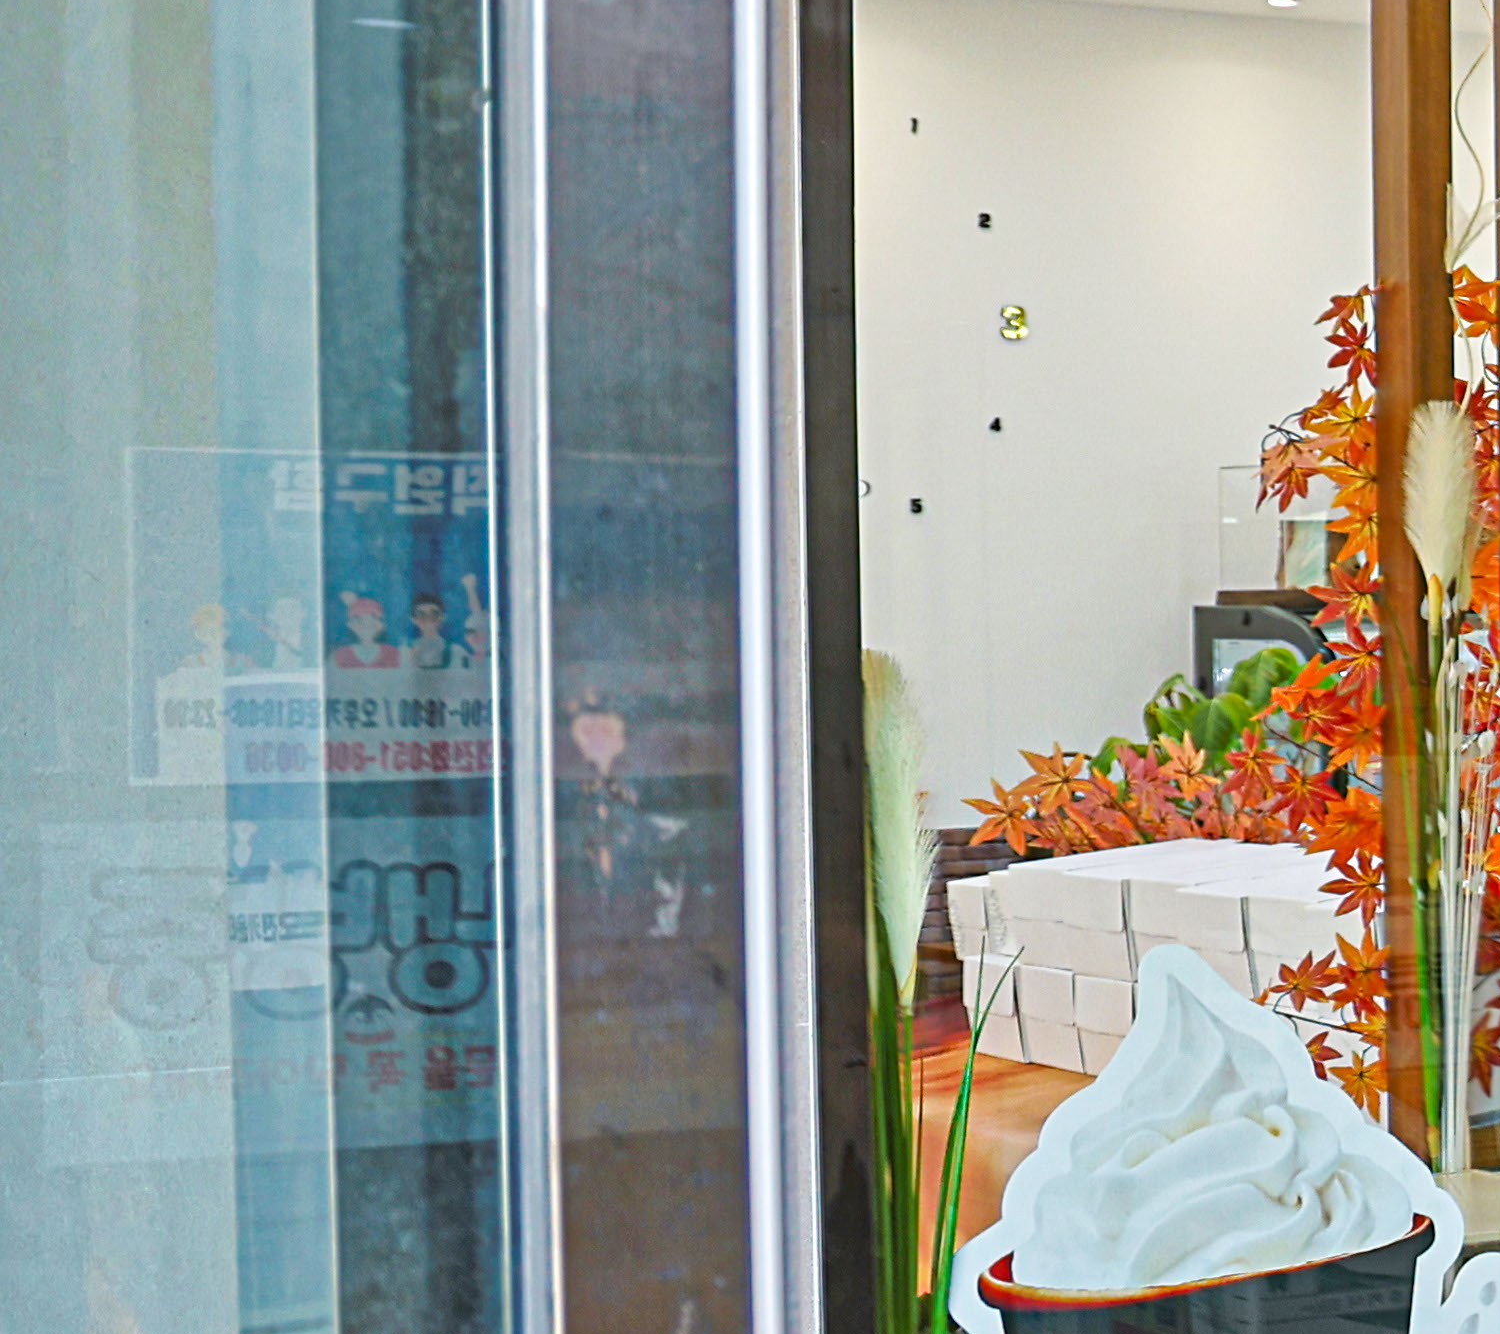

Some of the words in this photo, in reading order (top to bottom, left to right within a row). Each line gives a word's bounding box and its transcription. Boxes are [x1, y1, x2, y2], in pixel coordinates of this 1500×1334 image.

[977, 212, 992, 229] 2
[1000, 305, 1030, 341] 3
[989, 416, 1002, 432] 4
[909, 498, 923, 514] 5
